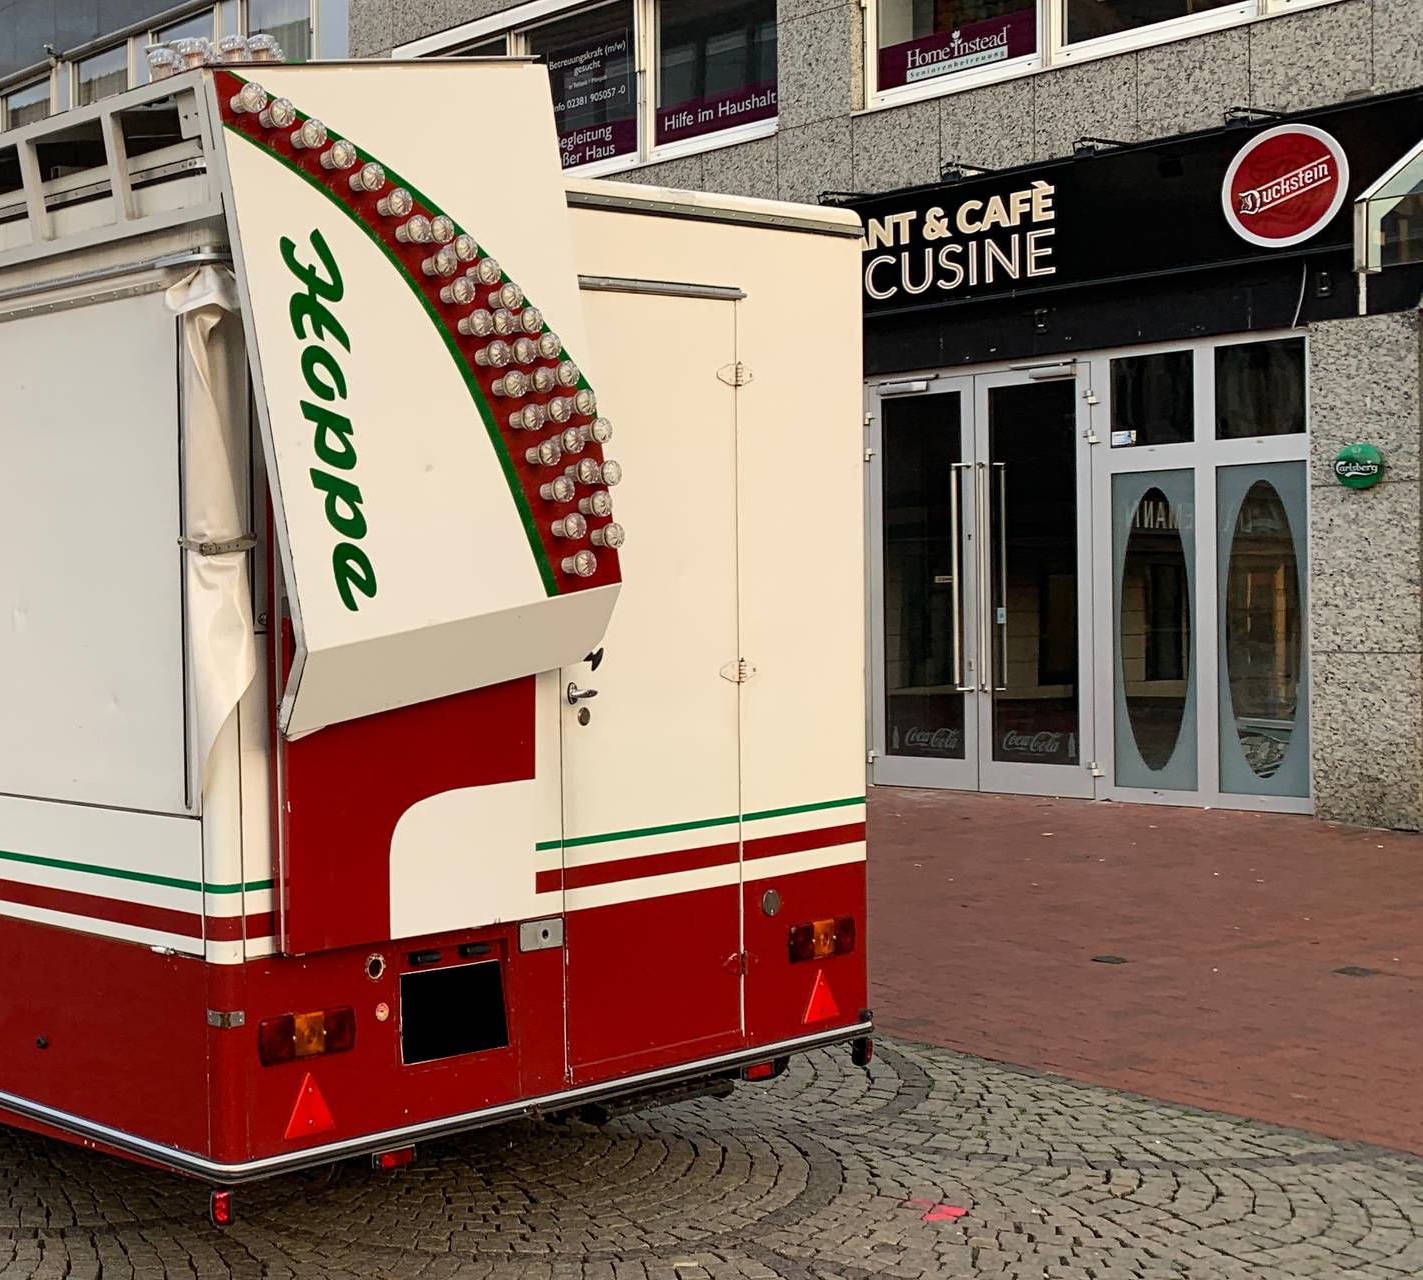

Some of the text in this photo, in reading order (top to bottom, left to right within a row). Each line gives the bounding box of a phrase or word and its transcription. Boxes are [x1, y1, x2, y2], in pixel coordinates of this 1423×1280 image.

[549, 40, 626, 71] Betreuungskraft (m/w)
[907, 26, 1008, 68] Home Instead
[574, 60, 601, 76] gesucht
[910, 50, 1006, 79] Seniorenbetreuung
[554, 103, 566, 112] nfo
[567, 96, 587, 109] 02381
[590, 87, 616, 102] 905057
[664, 90, 777, 131] Hilfe im Haushalt
[558, 126, 612, 151] egleitung
[562, 144, 615, 167] ßer Haus
[1238, 163, 1329, 214] Duckstein
[922, 206, 953, 241] &
[865, 228, 1056, 300] CUSINE
[279, 228, 378, 612] Hoppe
[1336, 460, 1378, 477] Carlsberg
